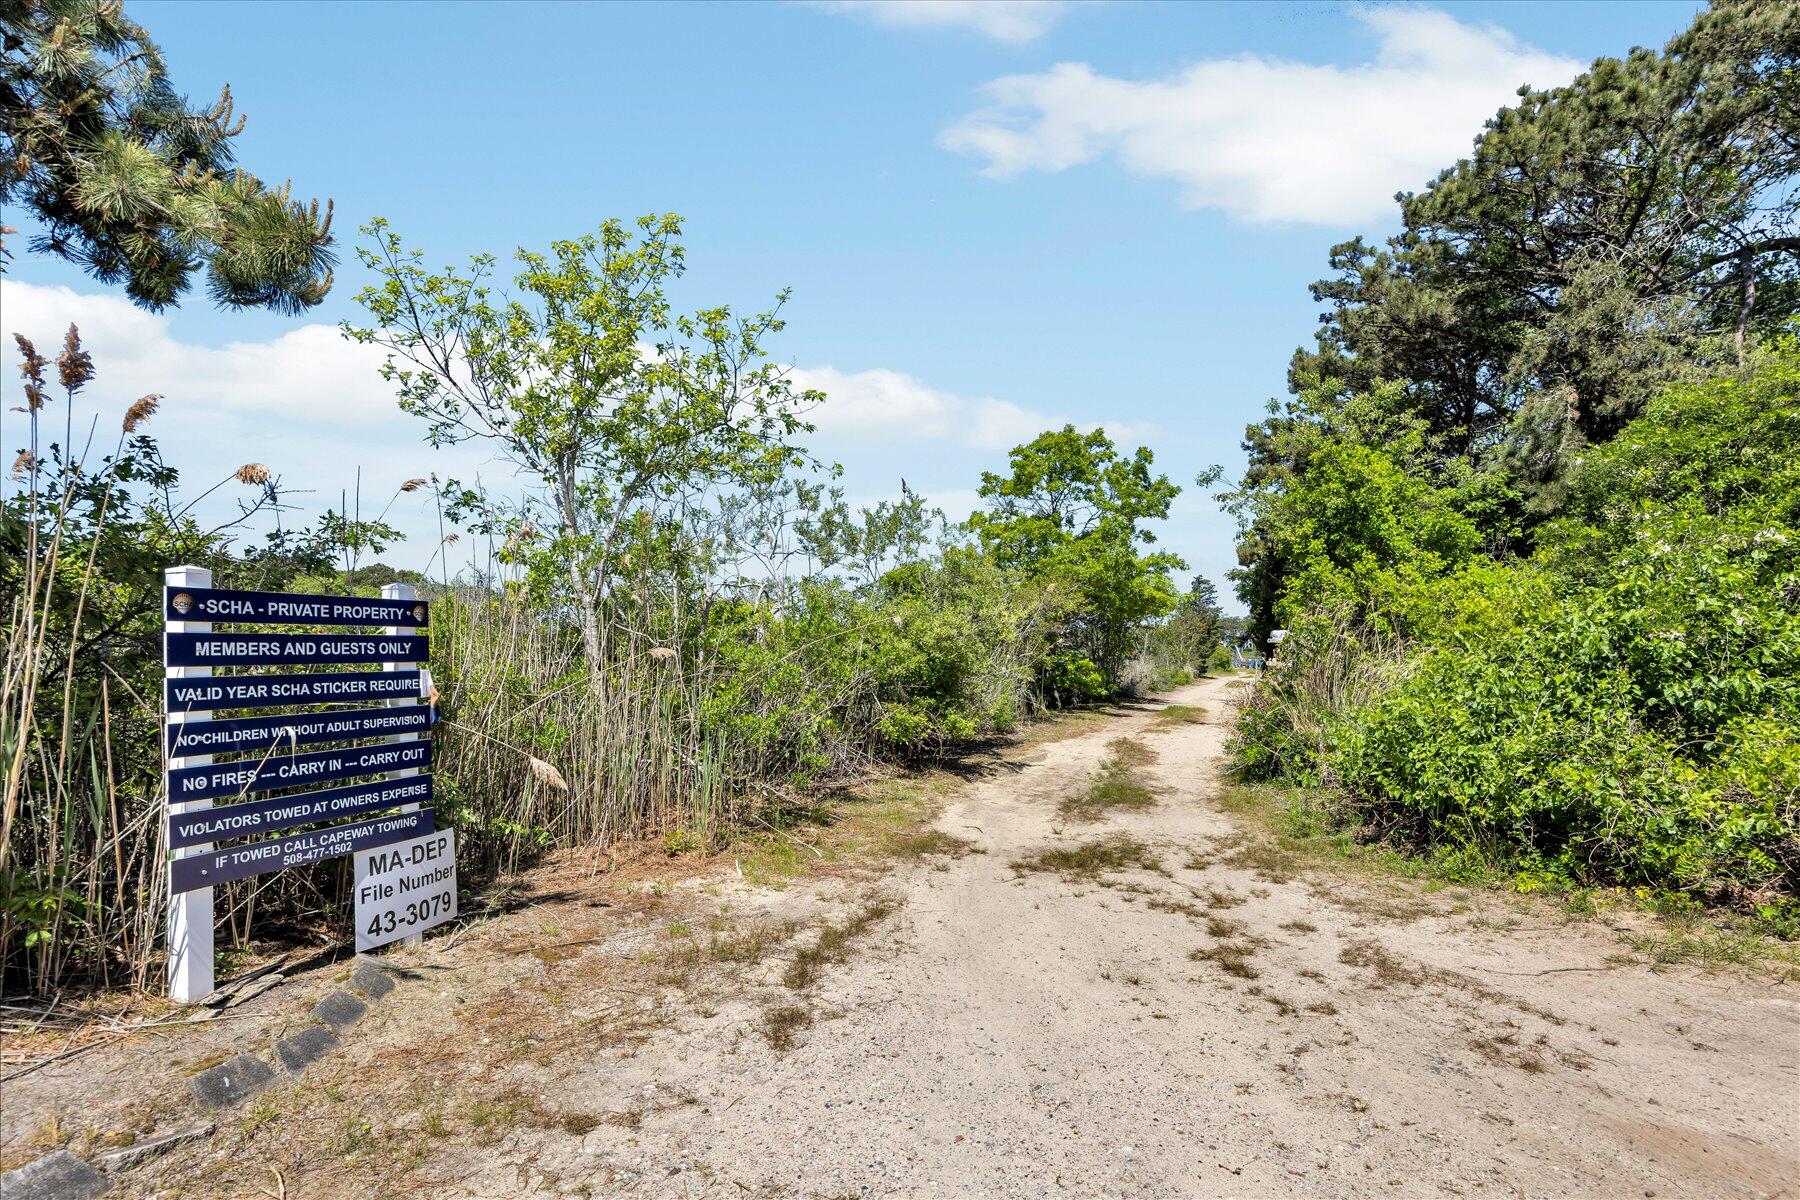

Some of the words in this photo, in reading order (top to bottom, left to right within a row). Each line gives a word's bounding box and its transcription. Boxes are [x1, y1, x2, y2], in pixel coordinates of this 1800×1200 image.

[206, 599, 255, 615] SCHA
[267, 602, 330, 618] PRIVATE
[333, 605, 404, 620] PROPERTY
[195, 641, 280, 656] MEMBERS
[284, 642, 317, 656] AND
[320, 642, 376, 655] GUESTS
[379, 642, 412, 654] ONLY
[175, 687, 223, 702] VALID
[226, 685, 268, 699] YEAR
[271, 683, 310, 697] SCHA
[313, 681, 367, 695] STICKER
[370, 678, 421, 692] REQUIRE
[177, 734, 199, 747] NO
[202, 728, 268, 744] CHILDREN
[326, 720, 361, 733] ADULT
[363, 714, 426, 729] SUPERVISION
[183, 776, 208, 791] NO
[212, 770, 257, 787] FIRES
[279, 760, 327, 778] CARRY
[329, 758, 342, 773] IN
[360, 751, 400, 767] CARRY
[402, 748, 425, 761] OUT
[179, 813, 261, 837] VIOLATORS
[264, 801, 311, 822] TOWED
[313, 801, 329, 815] AT
[331, 792, 380, 810] OWNERS
[382, 784, 428, 801] EXPENSE
[215, 855, 228, 869] IF
[231, 844, 281, 864] TOWED
[284, 837, 318, 853] CALL
[319, 825, 375, 847] CAPEWAY
[377, 816, 418, 833] TOWING
[283, 841, 353, 866] 508-477-1502
[368, 837, 448, 877] MA-DEP
[361, 883, 394, 905] File
[399, 864, 455, 894] Number
[367, 891, 452, 937] 43-3079
